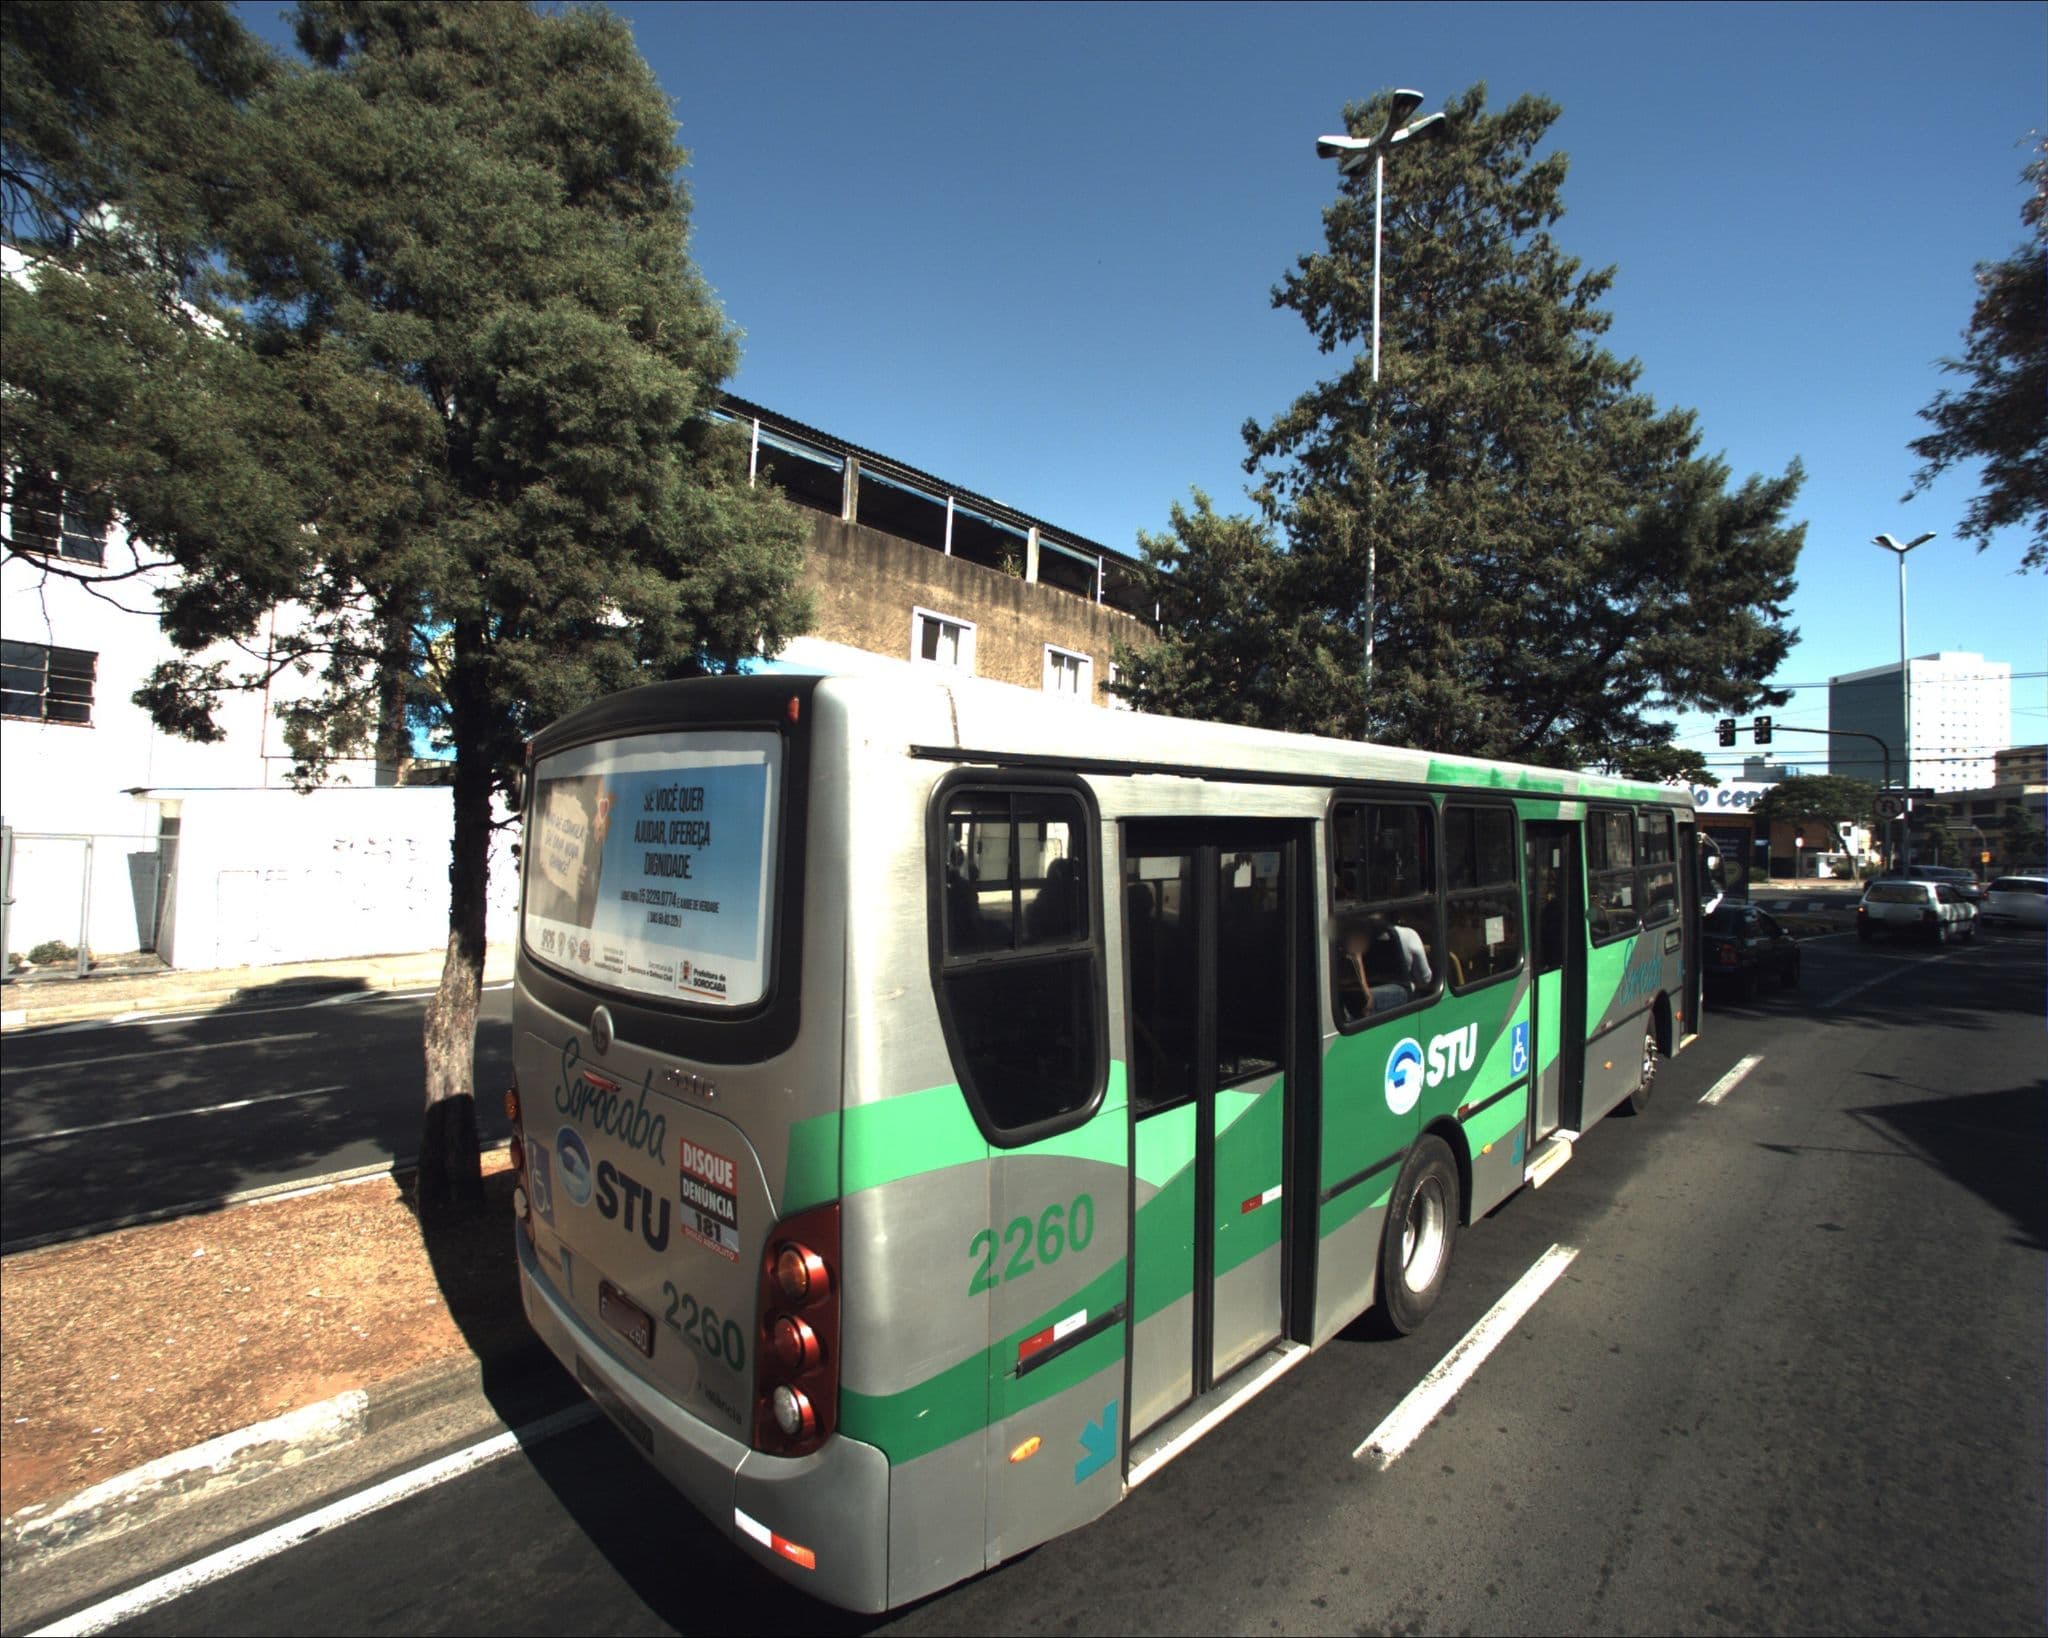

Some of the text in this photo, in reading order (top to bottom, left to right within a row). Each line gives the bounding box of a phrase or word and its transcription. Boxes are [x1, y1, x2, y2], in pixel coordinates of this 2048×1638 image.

[644, 782, 704, 813] SE VOCÊ QUER
[669, 820, 711, 851] OFEREÇA
[644, 852, 692, 879] DIGNIDADE.
[693, 967, 726, 982] Prefeitura de
[693, 977, 727, 992] SOROCABA
[1426, 1023, 1478, 1087] STU
[556, 1037, 666, 1166] Sorocaba
[683, 1142, 734, 1189] DISQUE
[596, 1160, 671, 1252] STU
[682, 1178, 734, 1221] DENÚNCIA
[695, 1212, 722, 1243] 181
[968, 1193, 1094, 1297] 2260
[663, 1280, 745, 1372] 2260
